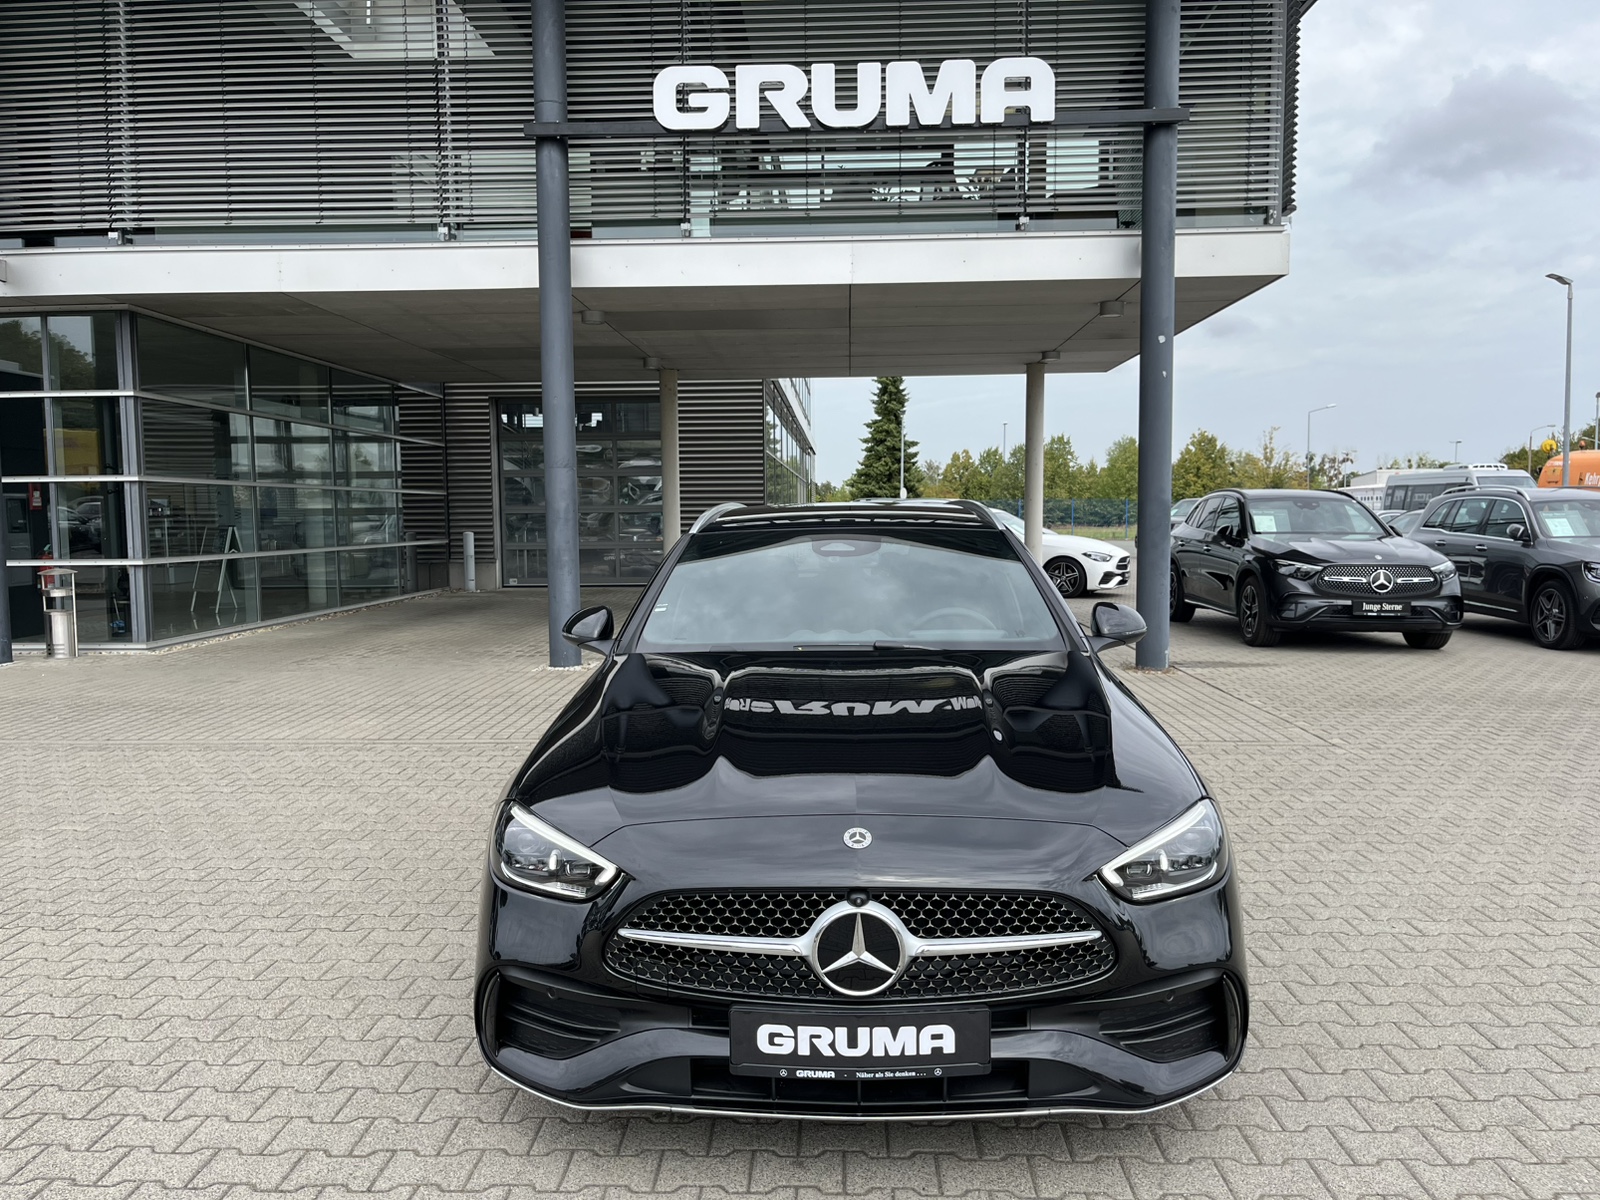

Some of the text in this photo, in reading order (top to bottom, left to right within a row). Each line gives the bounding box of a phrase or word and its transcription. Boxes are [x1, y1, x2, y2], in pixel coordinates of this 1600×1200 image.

[653, 57, 1056, 130] GRUMA
[1584, 472, 1600, 487] Kehr
[1363, 602, 1402, 612] Junge Sterne
[757, 1024, 956, 1057] GRUMA
[796, 1070, 835, 1078] GRUMA
